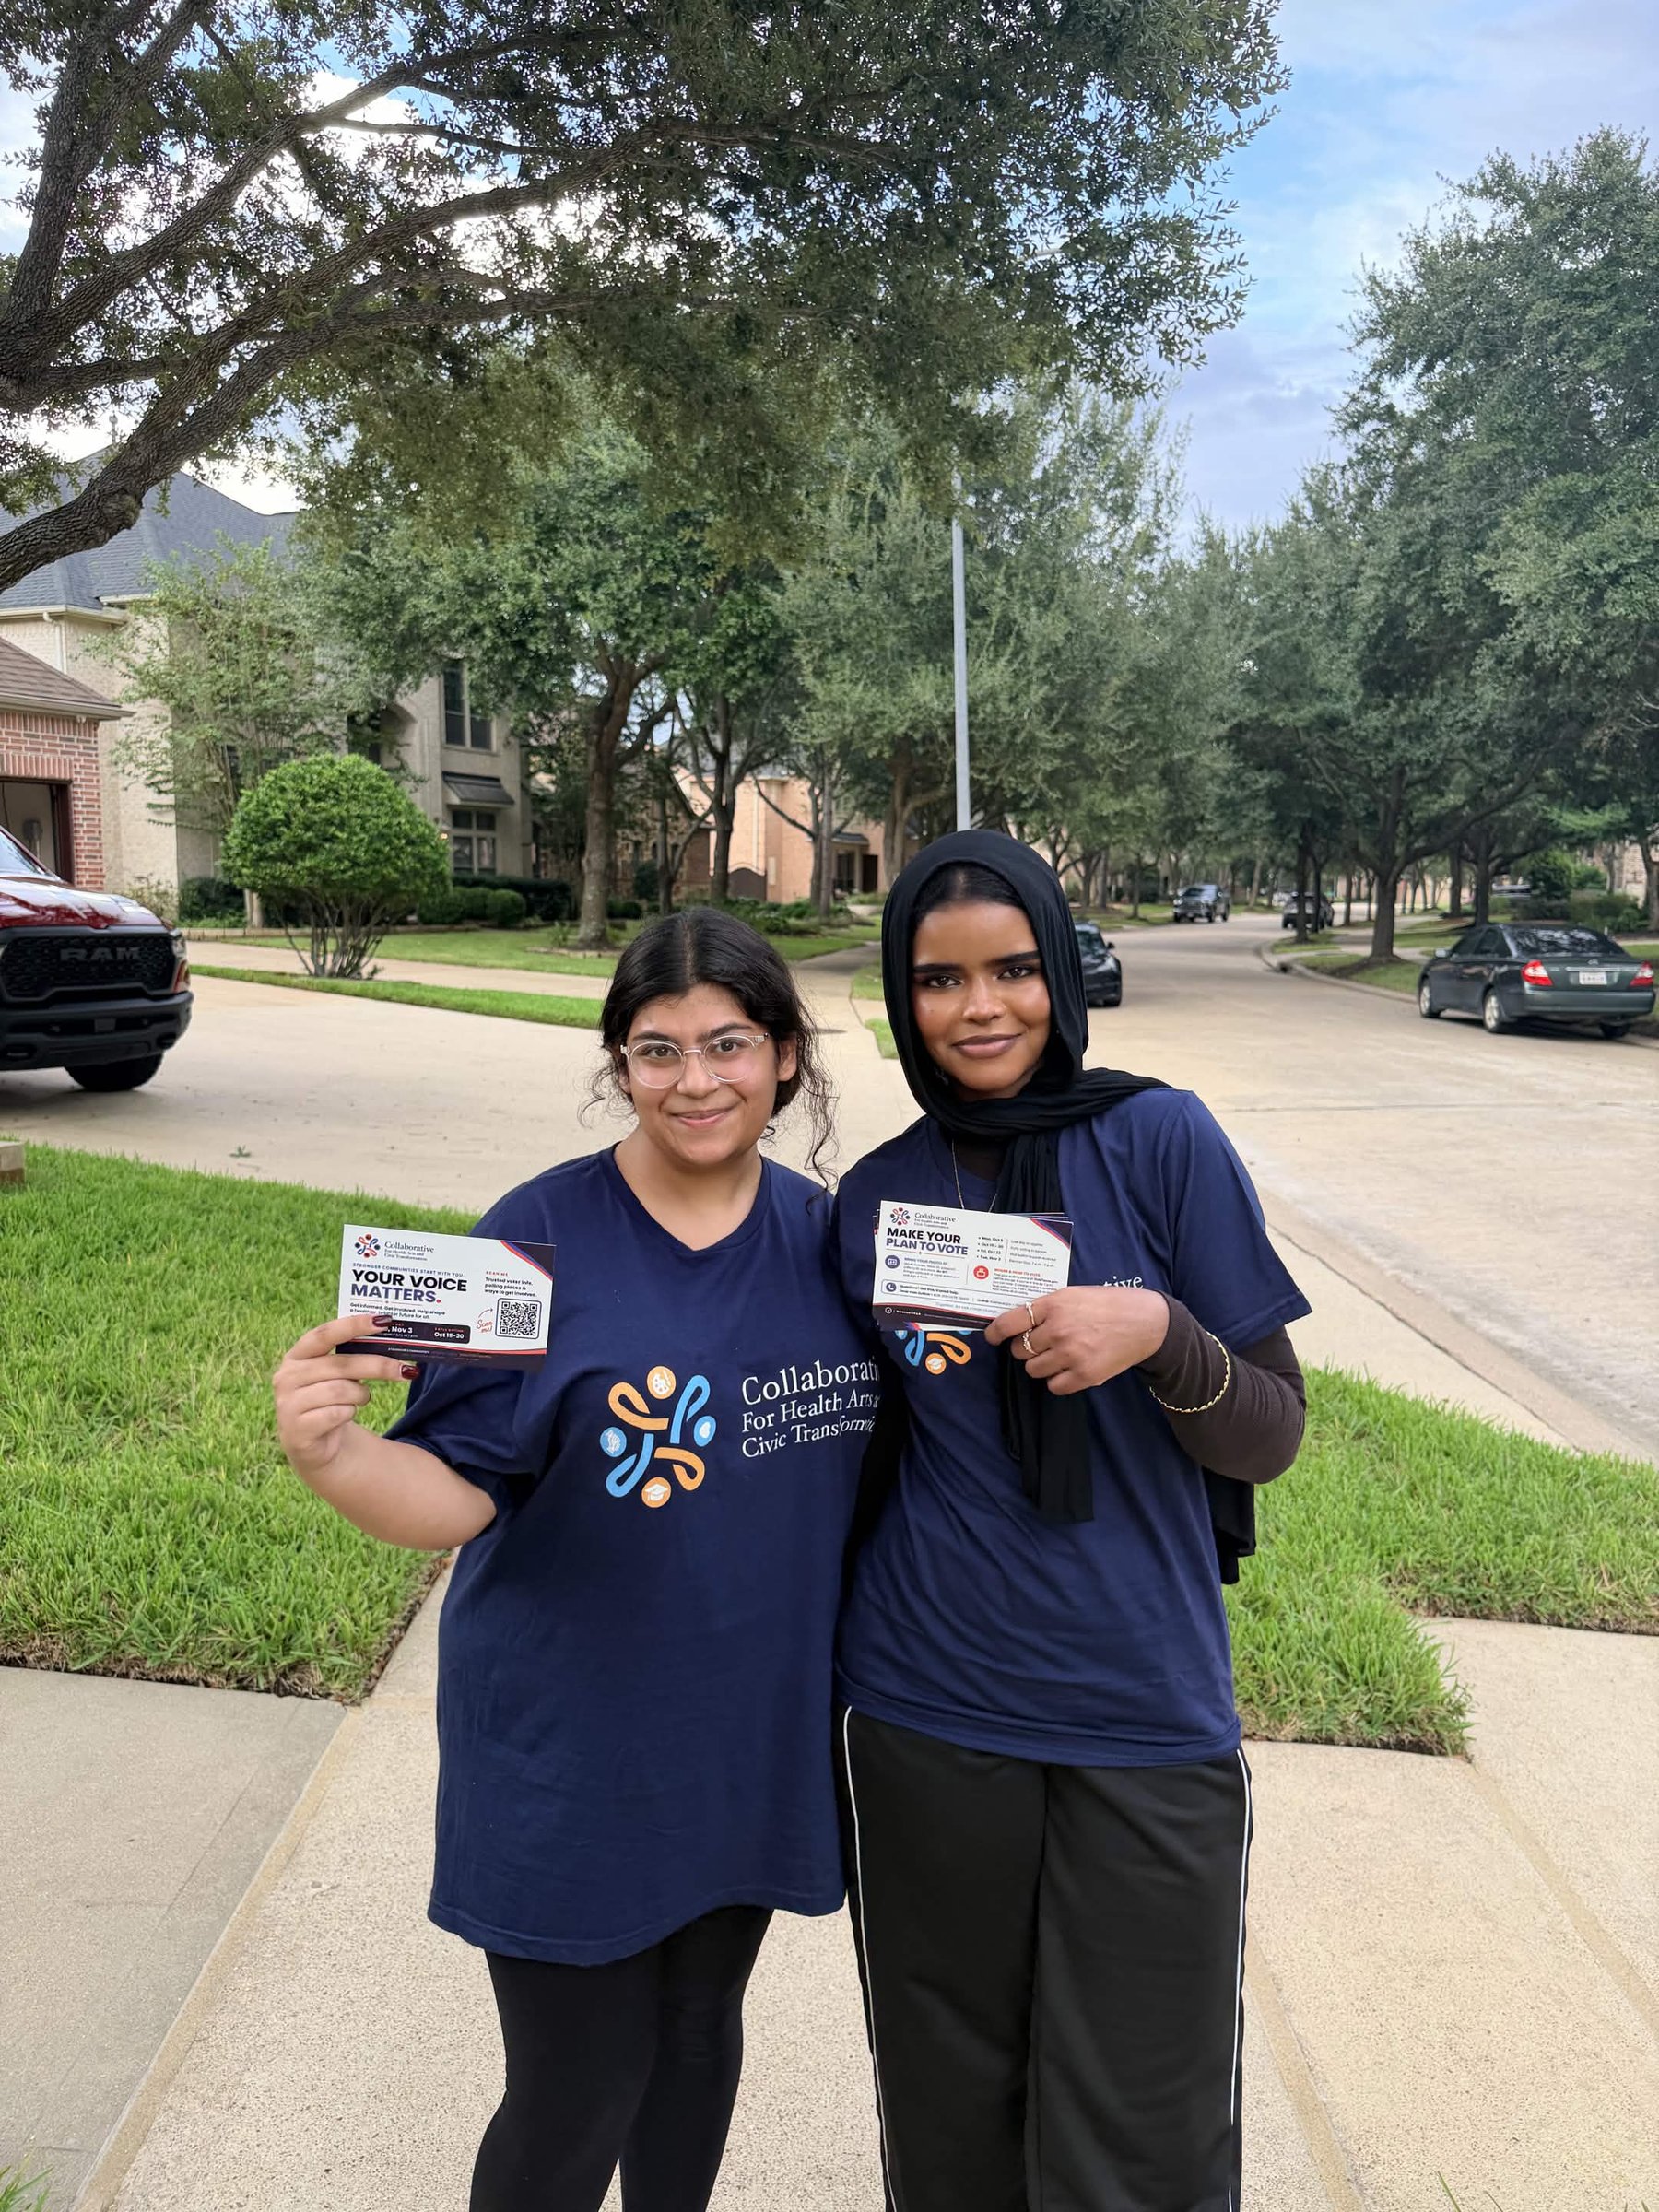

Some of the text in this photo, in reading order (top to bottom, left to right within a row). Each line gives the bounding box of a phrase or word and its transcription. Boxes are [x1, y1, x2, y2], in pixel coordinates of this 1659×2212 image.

[60, 947, 140, 961] RAM
[914, 1212, 957, 1222] Collaborative
[887, 1227, 961, 1244] MAKE YOUR
[384, 1241, 435, 1253] Collaborative
[886, 1237, 969, 1255] PLAN TO VOTE
[382, 1265, 418, 1274] COMMUNITIES
[352, 1269, 467, 1292] YOUR VOICE
[351, 1283, 441, 1304] MATTERS.
[477, 1319, 493, 1330] Scan
[742, 1411, 774, 1433] For
[780, 1391, 842, 1423] Health
[845, 1388, 873, 1409] Arts
[742, 1432, 786, 1458] Civic
